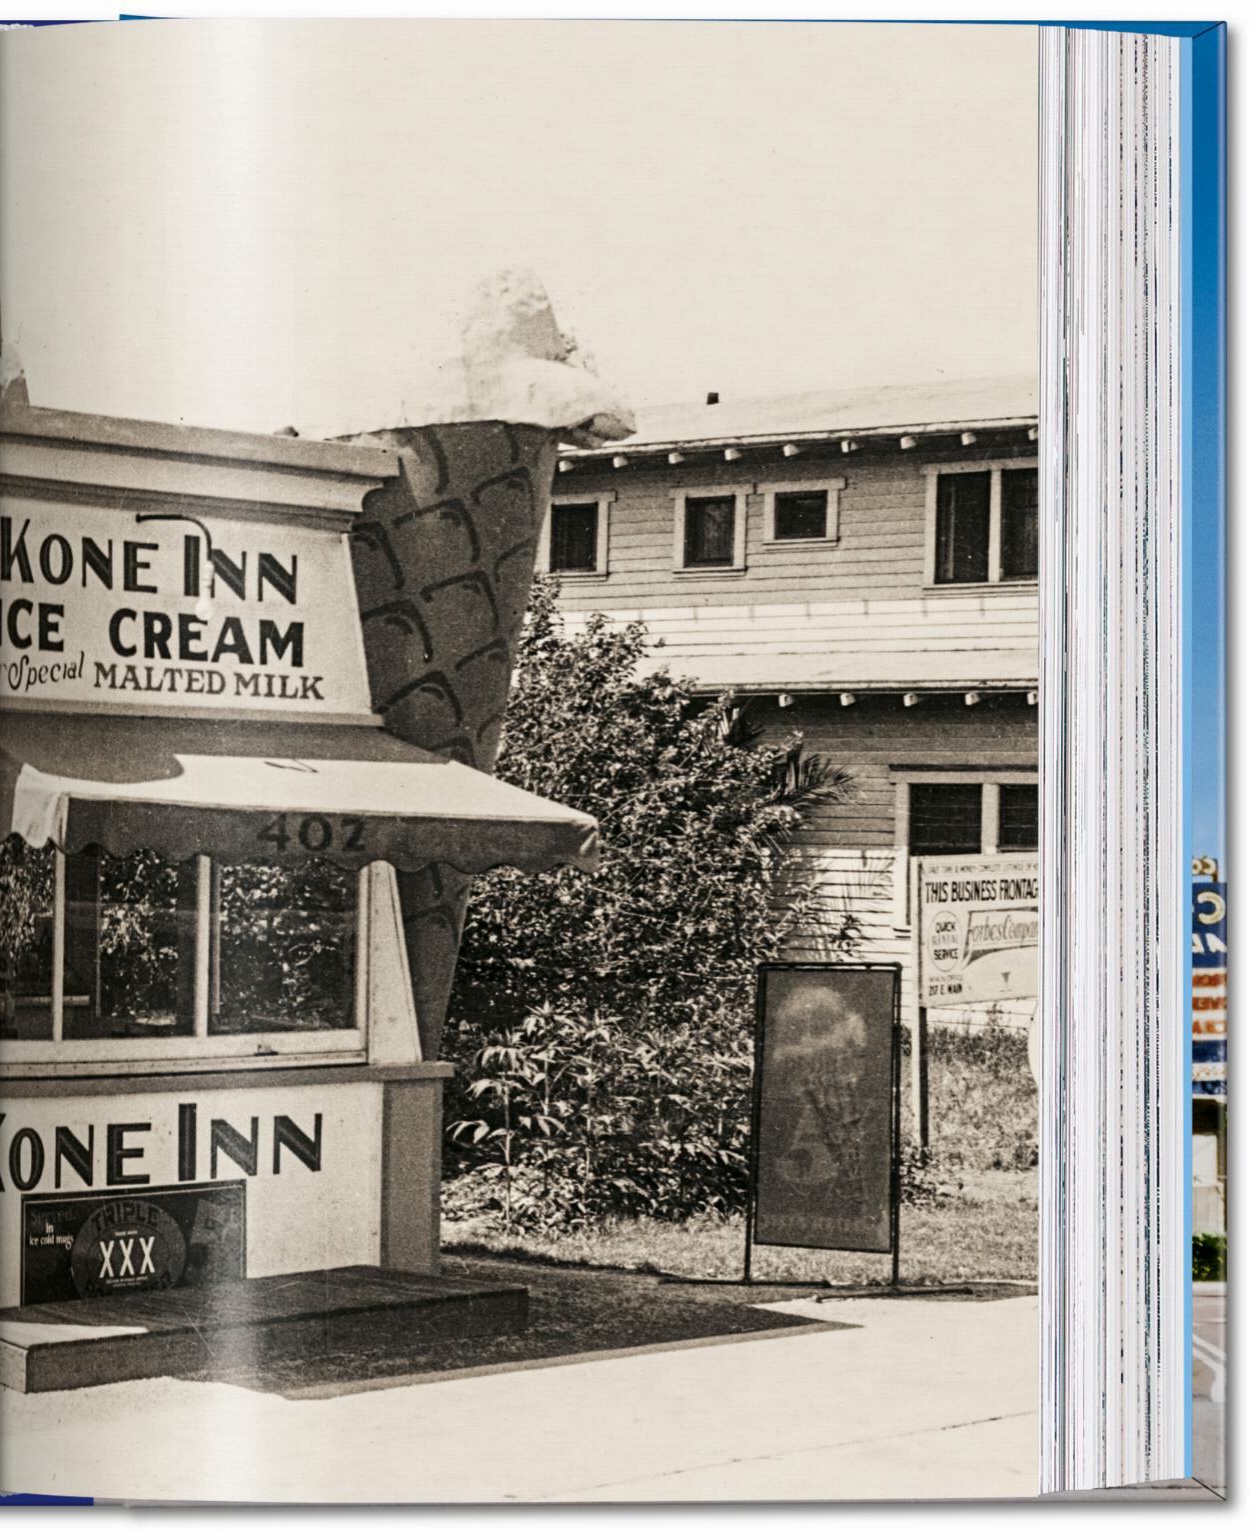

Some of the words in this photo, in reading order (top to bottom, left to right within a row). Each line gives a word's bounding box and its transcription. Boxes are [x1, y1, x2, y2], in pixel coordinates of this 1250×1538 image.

[0, 516, 159, 594] KONE
[184, 535, 298, 605] INN
[108, 608, 304, 668] CREAM
[7, 650, 85, 693] Special
[93, 661, 226, 696] MALTED
[233, 672, 325, 701] MILK
[256, 812, 366, 852] 402
[925, 881, 948, 903] THIS
[951, 880, 997, 902] BUSINESS
[933, 948, 959, 960] SERVICE
[178, 1102, 323, 1182] INN
[92, 1201, 160, 1232] TRIPLE
[99, 1235, 156, 1279] XXX
